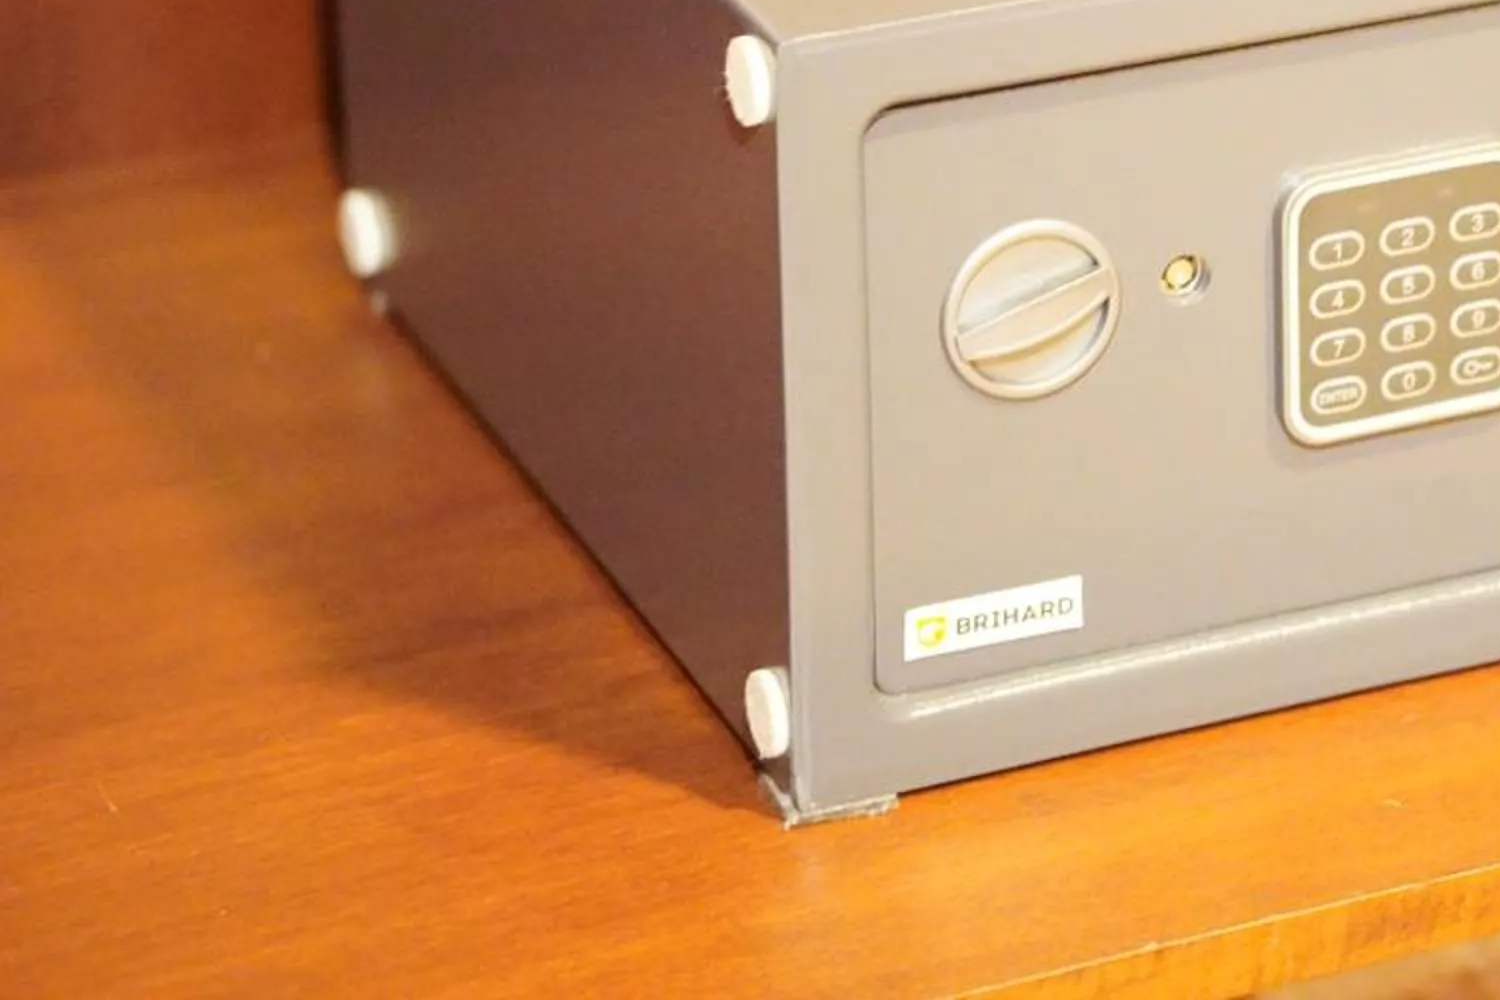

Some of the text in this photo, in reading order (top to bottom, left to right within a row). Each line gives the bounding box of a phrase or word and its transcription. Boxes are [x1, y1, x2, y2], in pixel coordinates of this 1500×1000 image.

[1471, 213, 1485, 234] 3
[1401, 228, 1415, 248] 2
[1332, 242, 1344, 264] 1
[1471, 261, 1486, 281] 6
[1331, 290, 1344, 309] 4
[1332, 338, 1346, 358] 7
[1402, 372, 1416, 391] 0
[956, 597, 1074, 635] BRIHARD
